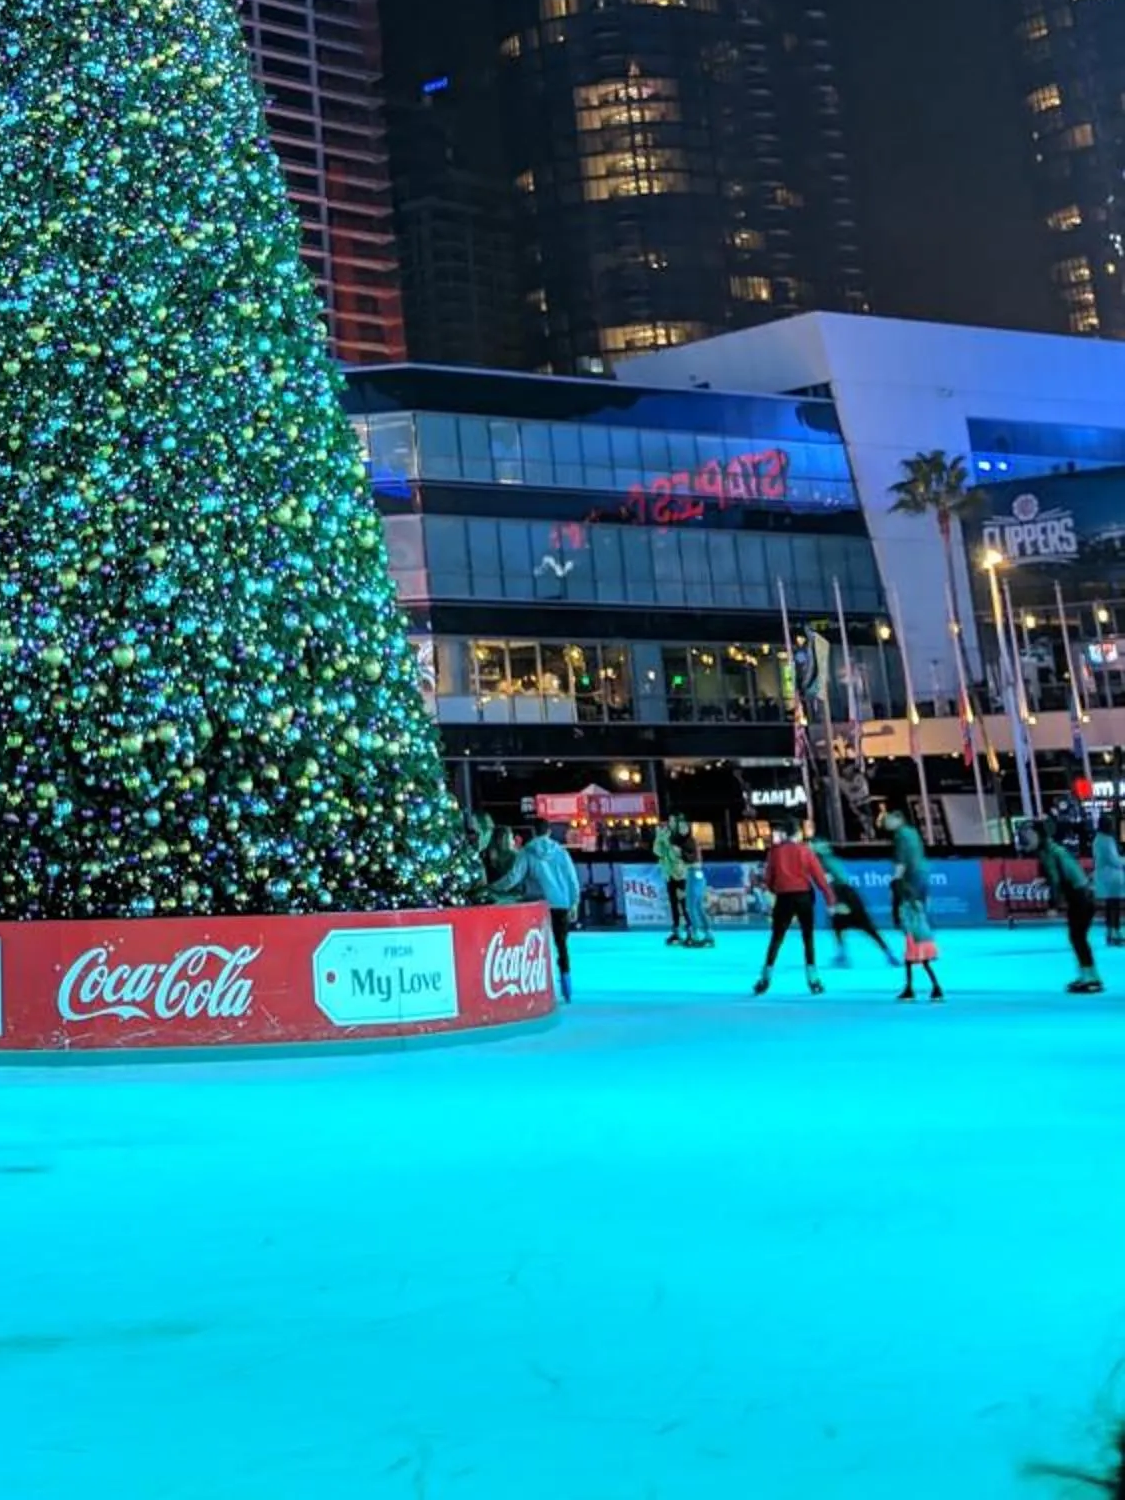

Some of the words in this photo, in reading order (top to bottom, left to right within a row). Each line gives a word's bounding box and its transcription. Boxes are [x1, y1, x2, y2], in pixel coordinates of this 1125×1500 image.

[57, 944, 263, 1021] Coca-Cola
[351, 967, 392, 1002] My
[398, 966, 442, 994] Love
